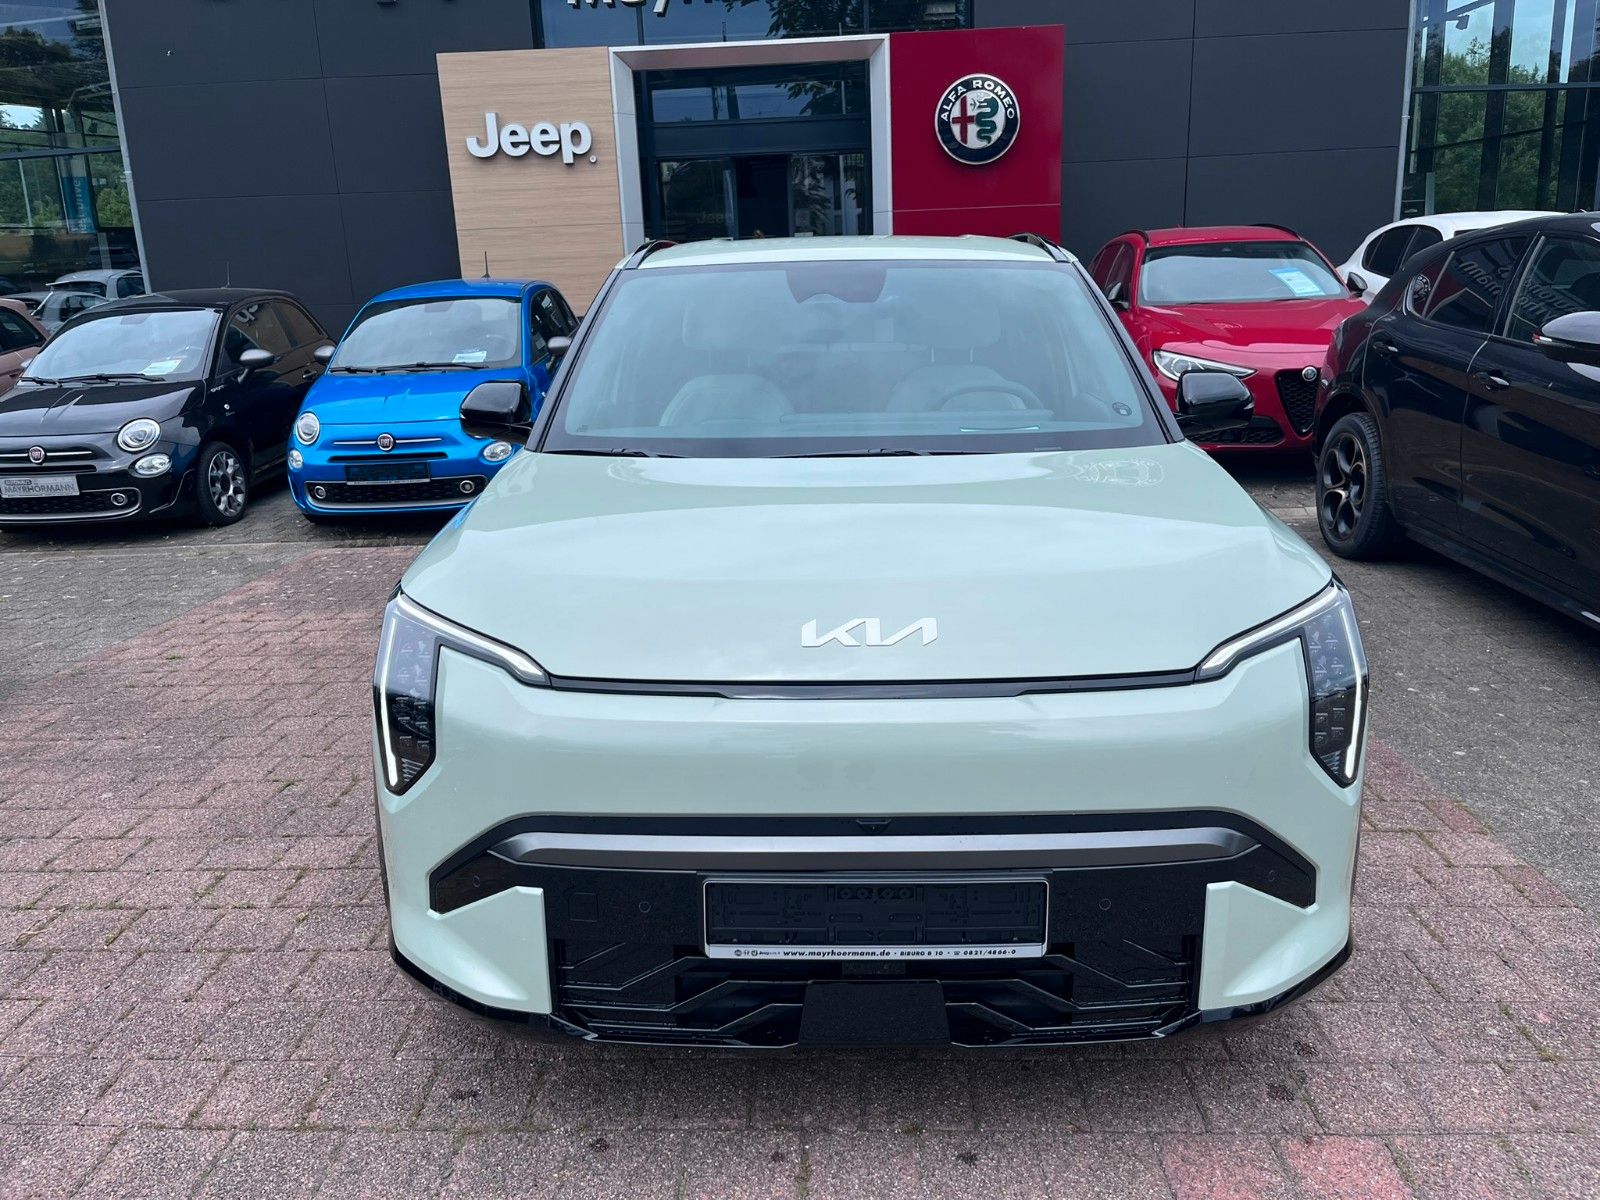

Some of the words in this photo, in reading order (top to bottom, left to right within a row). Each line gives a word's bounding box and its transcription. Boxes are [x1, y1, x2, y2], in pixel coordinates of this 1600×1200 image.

[940, 85, 967, 122] ALFA
[972, 79, 1016, 119] ROMEO
[466, 111, 592, 164] Jeep
[801, 617, 938, 647] KIA
